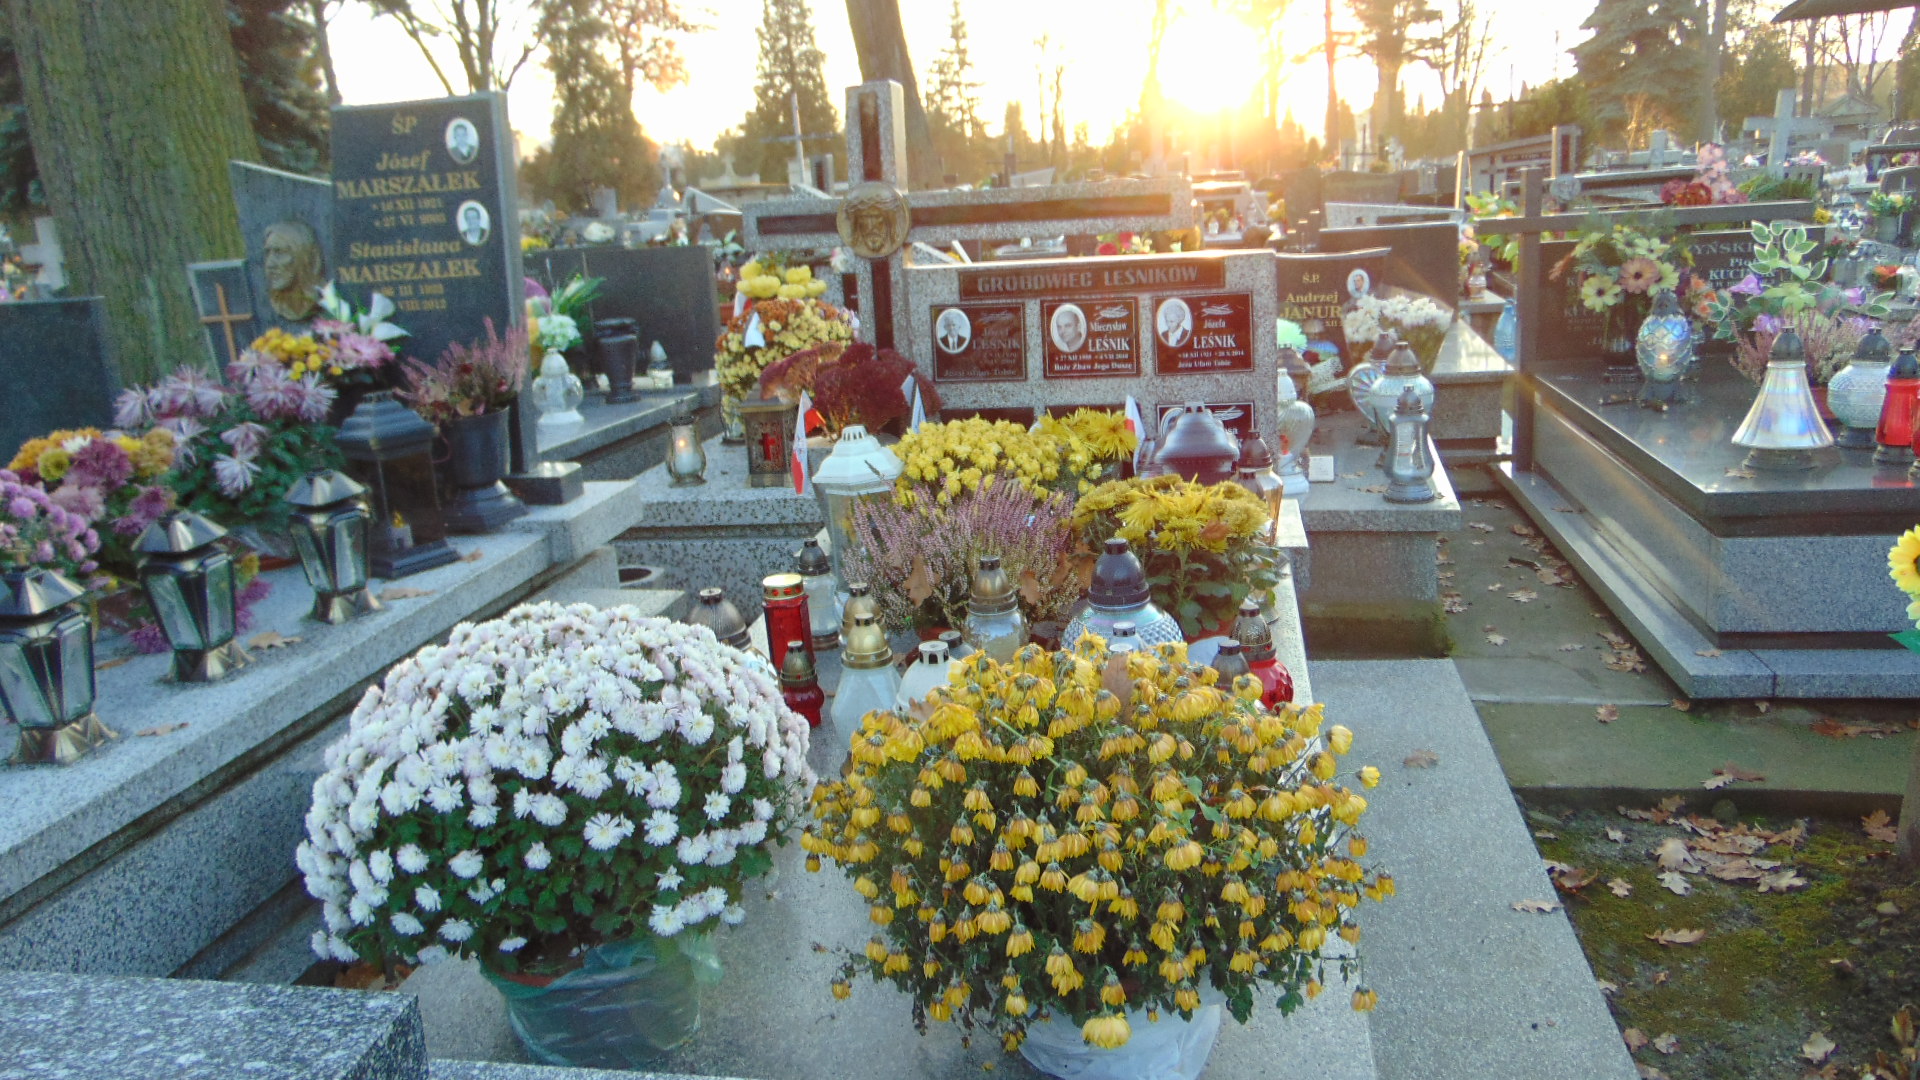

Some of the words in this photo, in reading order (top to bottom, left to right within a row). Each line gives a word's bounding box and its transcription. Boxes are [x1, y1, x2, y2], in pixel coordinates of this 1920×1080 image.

[375, 149, 431, 171] Józef
[350, 238, 461, 259] Stanisława
[977, 271, 1093, 293] GROBOWIEC
[1285, 291, 1339, 304] Andrzej
[1089, 319, 1127, 335] Mieczysław
[1088, 332, 1130, 352] LEŚNIK
[1193, 332, 1236, 350] LEŚNIK
